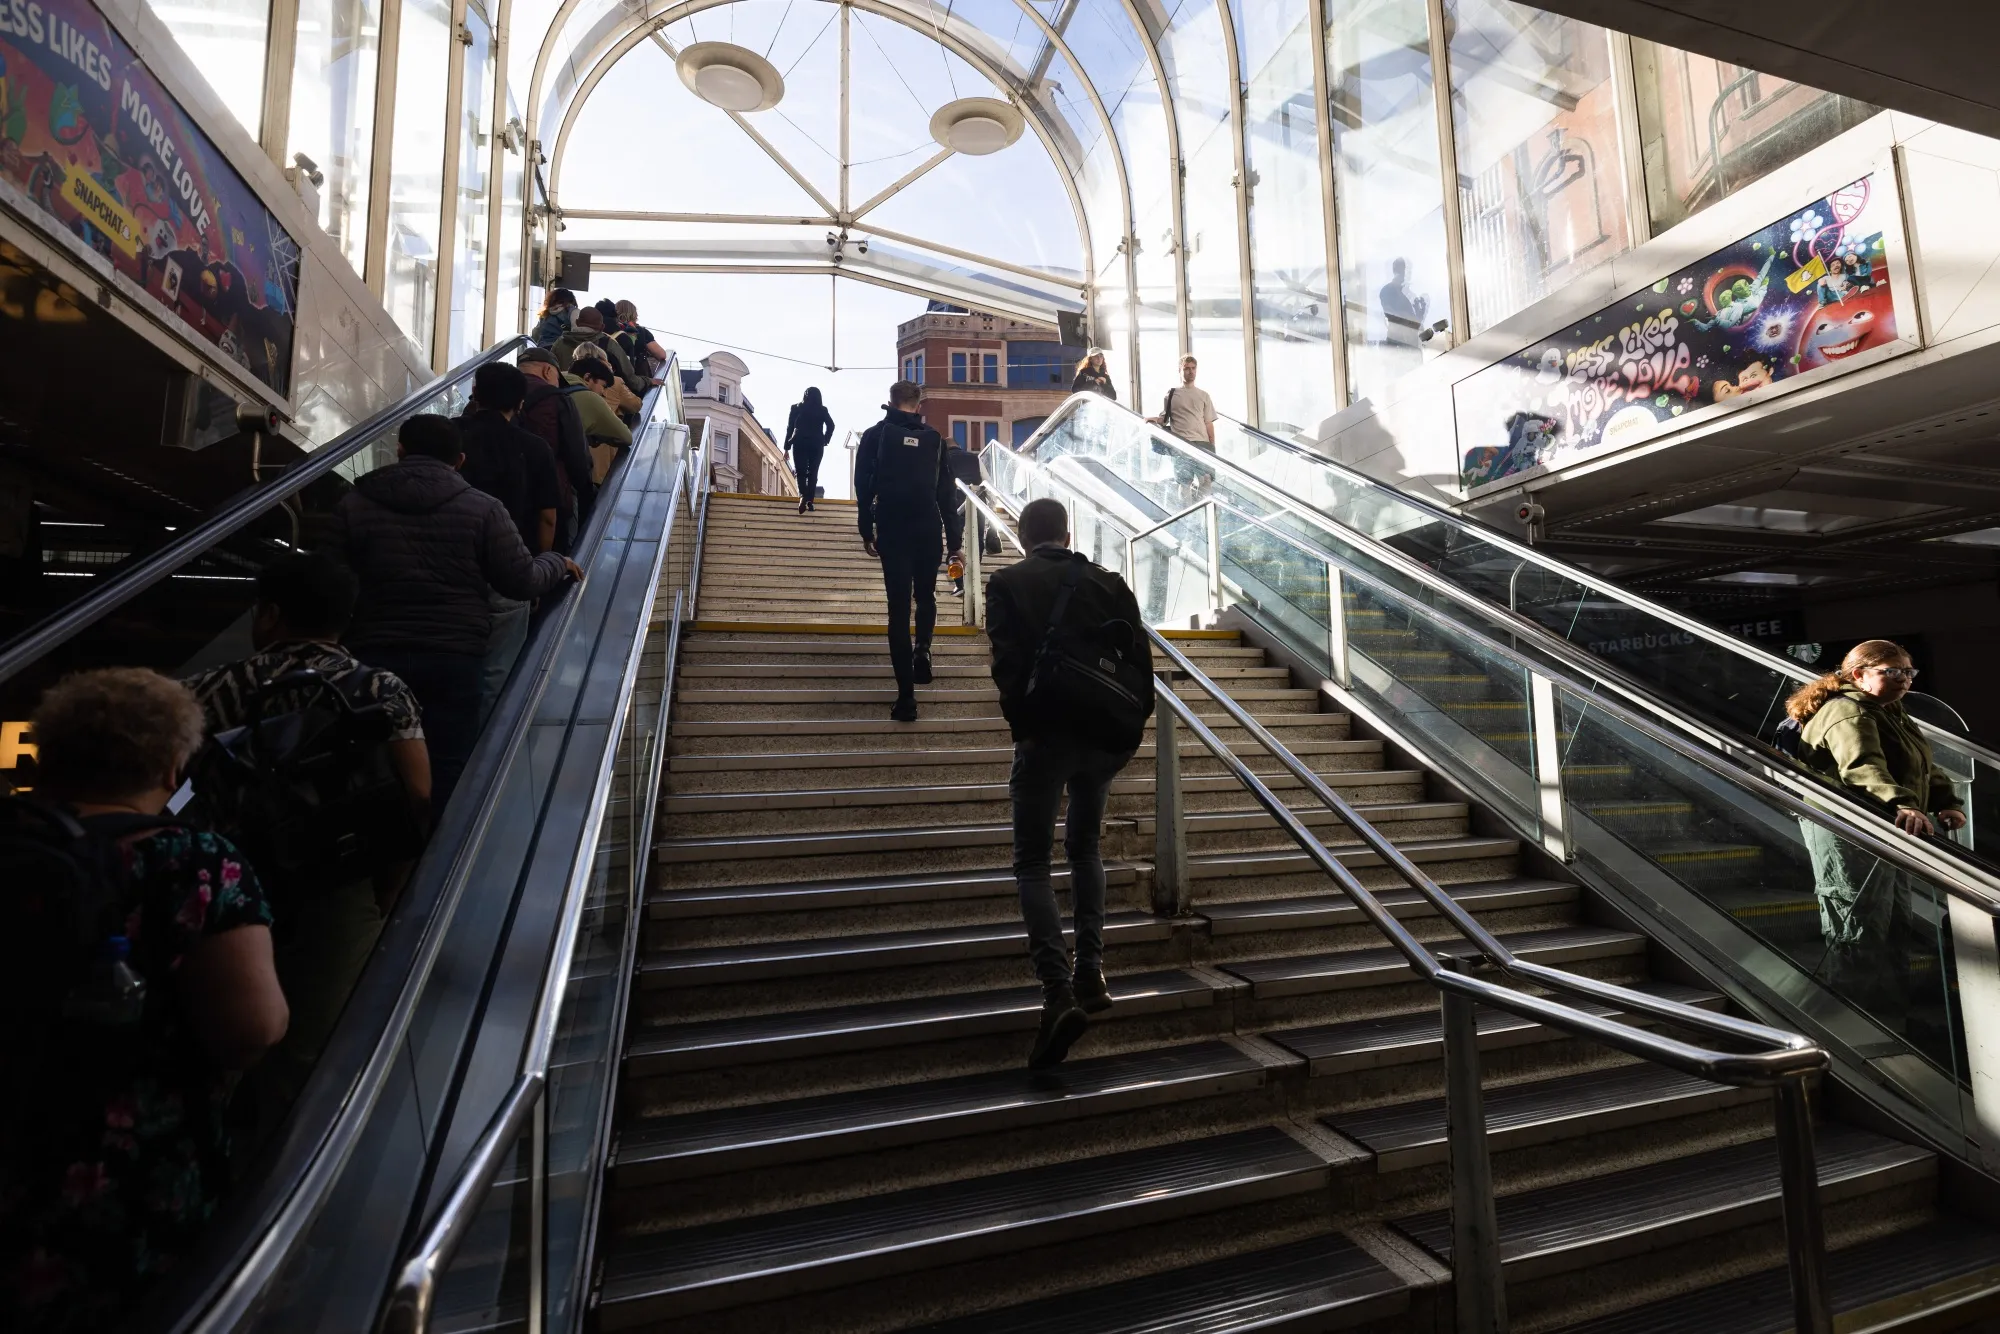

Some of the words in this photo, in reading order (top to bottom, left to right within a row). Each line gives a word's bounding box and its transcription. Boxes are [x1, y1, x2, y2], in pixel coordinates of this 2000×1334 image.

[49, 13, 112, 91] LIKES
[121, 78, 175, 170] MORE
[172, 156, 211, 235] LOVE
[73, 177, 123, 234] SNAPCHAT
[1609, 416, 1639, 436] SNAPCHAT
[1588, 631, 1695, 654] STARBUCKS
